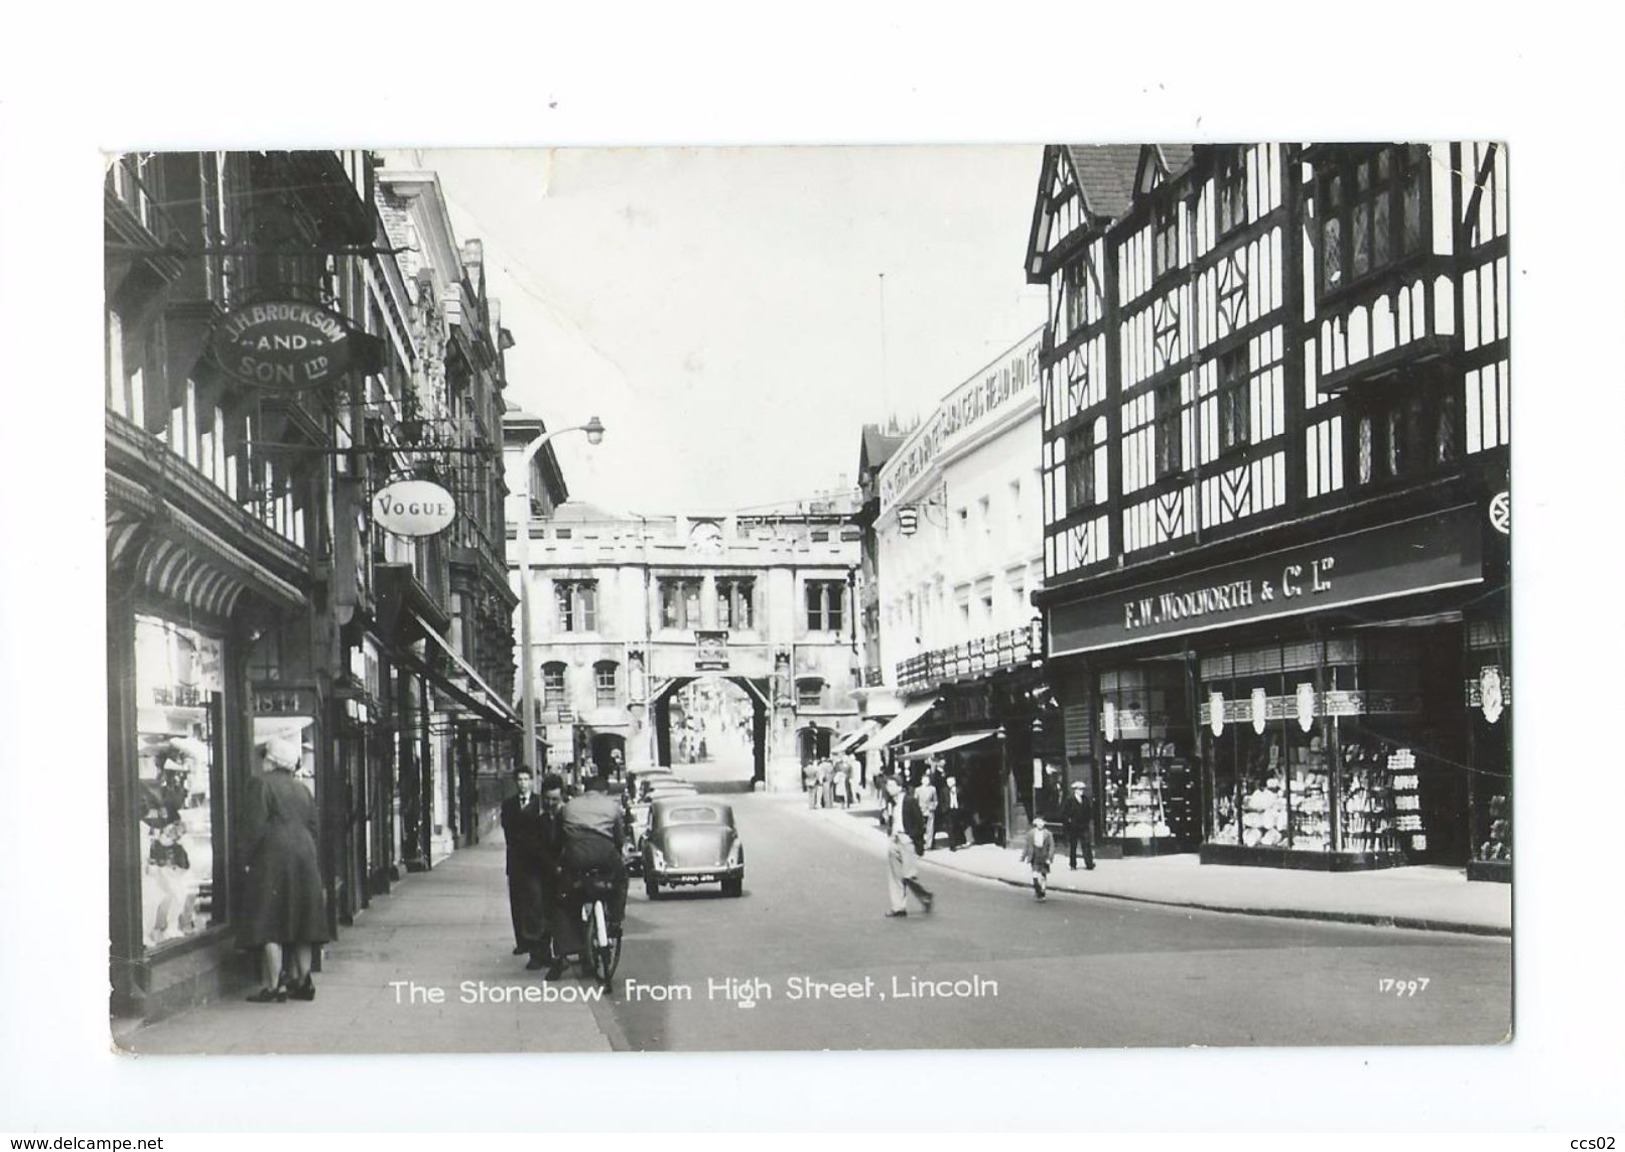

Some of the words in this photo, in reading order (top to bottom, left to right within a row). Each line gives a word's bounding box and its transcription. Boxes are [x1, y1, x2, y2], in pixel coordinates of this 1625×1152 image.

[257, 335, 307, 349] AND
[241, 356, 295, 383] SON
[304, 355, 328, 379] LTD
[379, 494, 448, 515] VOGUE
[1261, 581, 1274, 600] &
